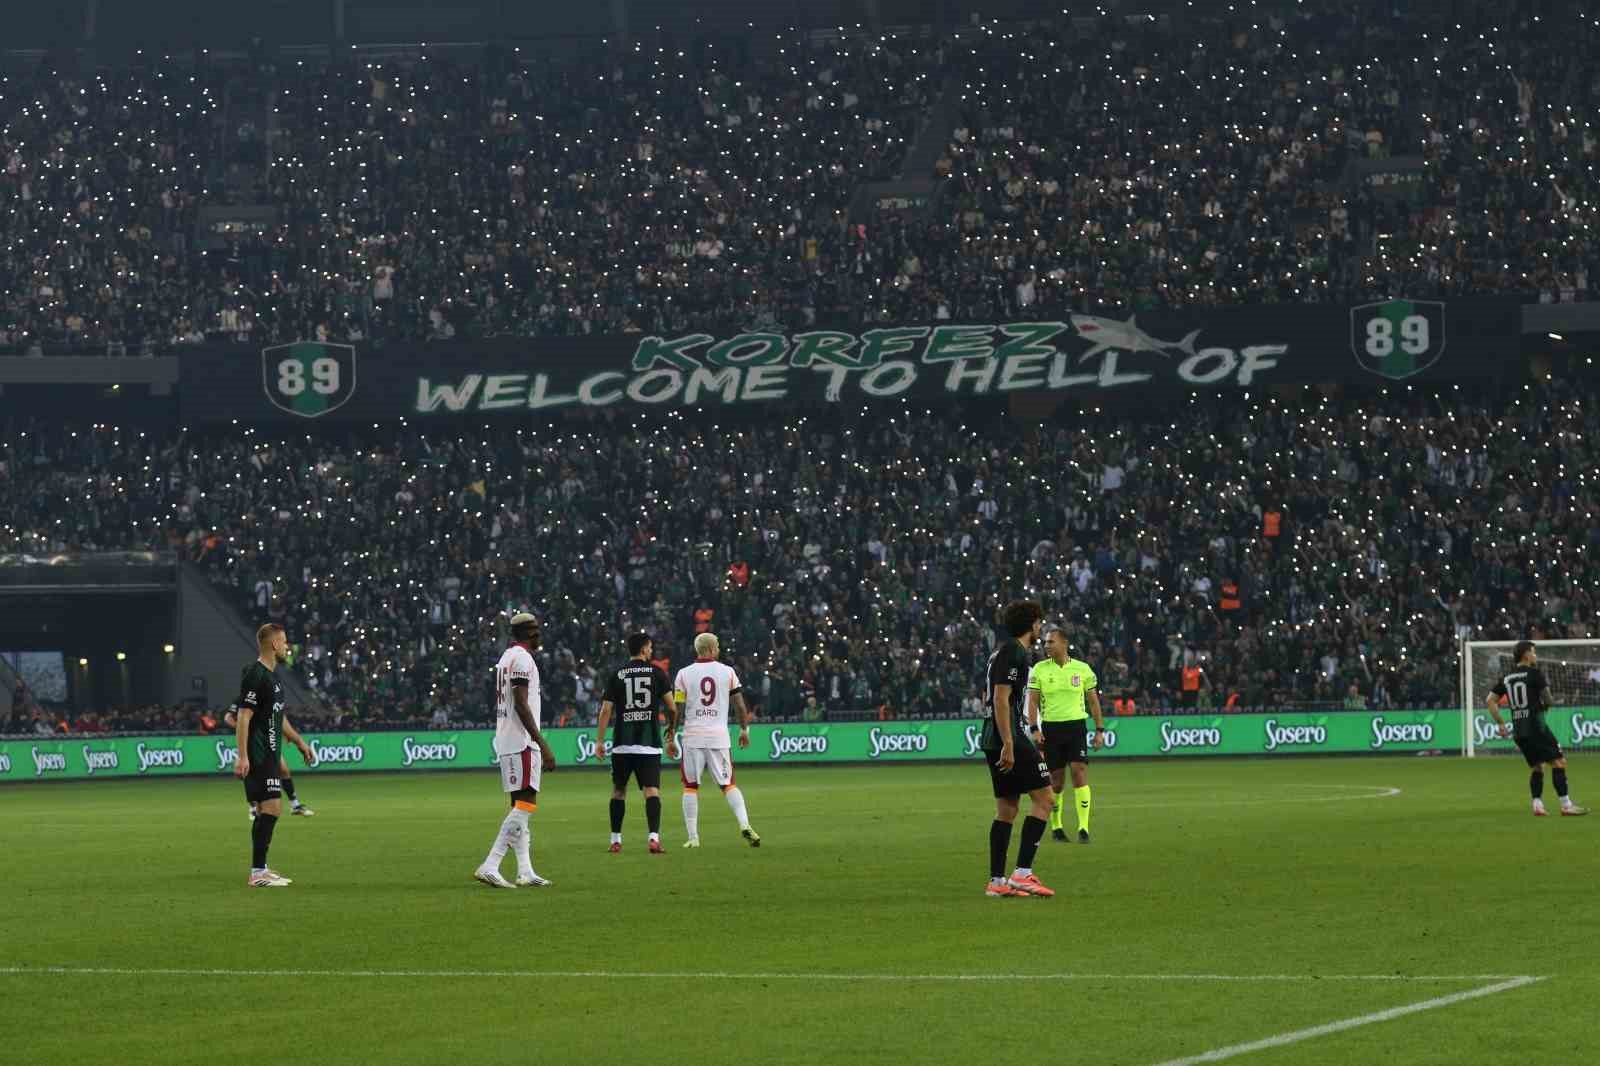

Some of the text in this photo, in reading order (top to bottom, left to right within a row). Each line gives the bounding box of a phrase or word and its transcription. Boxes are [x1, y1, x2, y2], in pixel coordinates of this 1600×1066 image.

[1366, 314, 1430, 357] 89
[277, 357, 340, 396] 89
[415, 344, 1289, 413] WELCOME TO HELL OF
[624, 677, 652, 709] 15
[701, 677, 716, 706] 9
[623, 710, 653, 722] SERBEST
[1571, 713, 1600, 743] Sos
[770, 730, 827, 758] Sosero
[869, 728, 927, 757] Sosero
[1160, 721, 1220, 752] Sosero
[1264, 720, 1327, 750] Sosero
[1371, 718, 1433, 749] Sosero
[32, 746, 66, 775] Sosero
[82, 745, 118, 774] Sosero
[137, 743, 184, 771] Sosero
[216, 741, 239, 769] Sos
[309, 739, 363, 767] Sosero
[402, 738, 457, 767] Sosero
